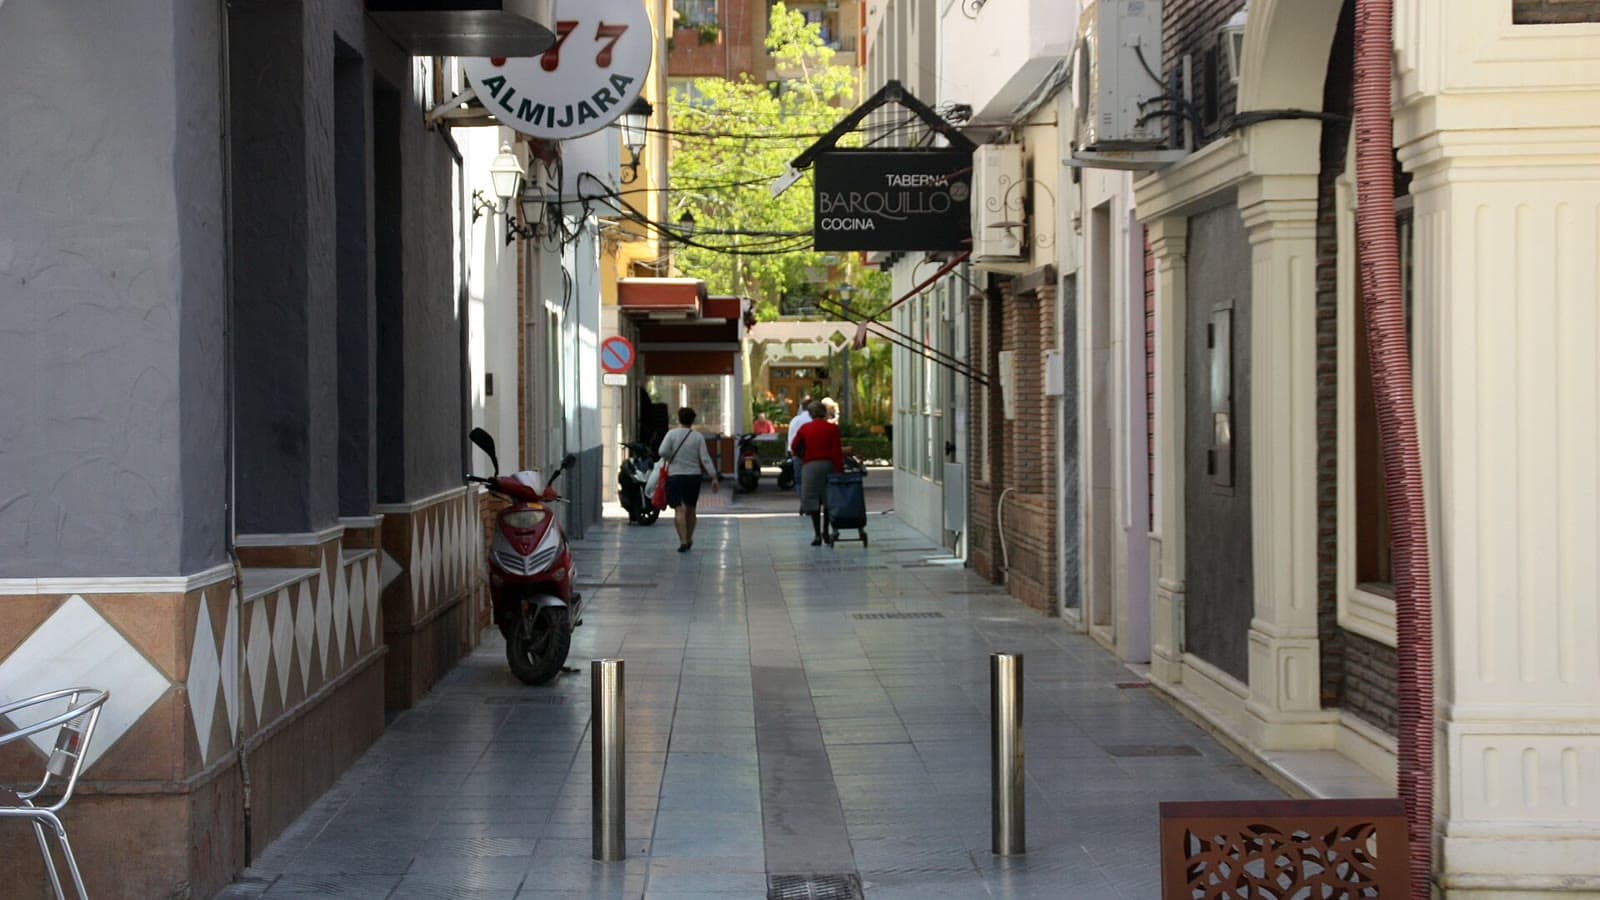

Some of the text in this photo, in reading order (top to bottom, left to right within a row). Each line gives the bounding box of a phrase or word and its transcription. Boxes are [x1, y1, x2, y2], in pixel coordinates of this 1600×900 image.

[491, 20, 629, 72] 77
[481, 73, 634, 128] ALMIJARA
[886, 174, 948, 187] TABERNA
[819, 192, 950, 220] BARQUILLO
[821, 217, 875, 230] COCINA
